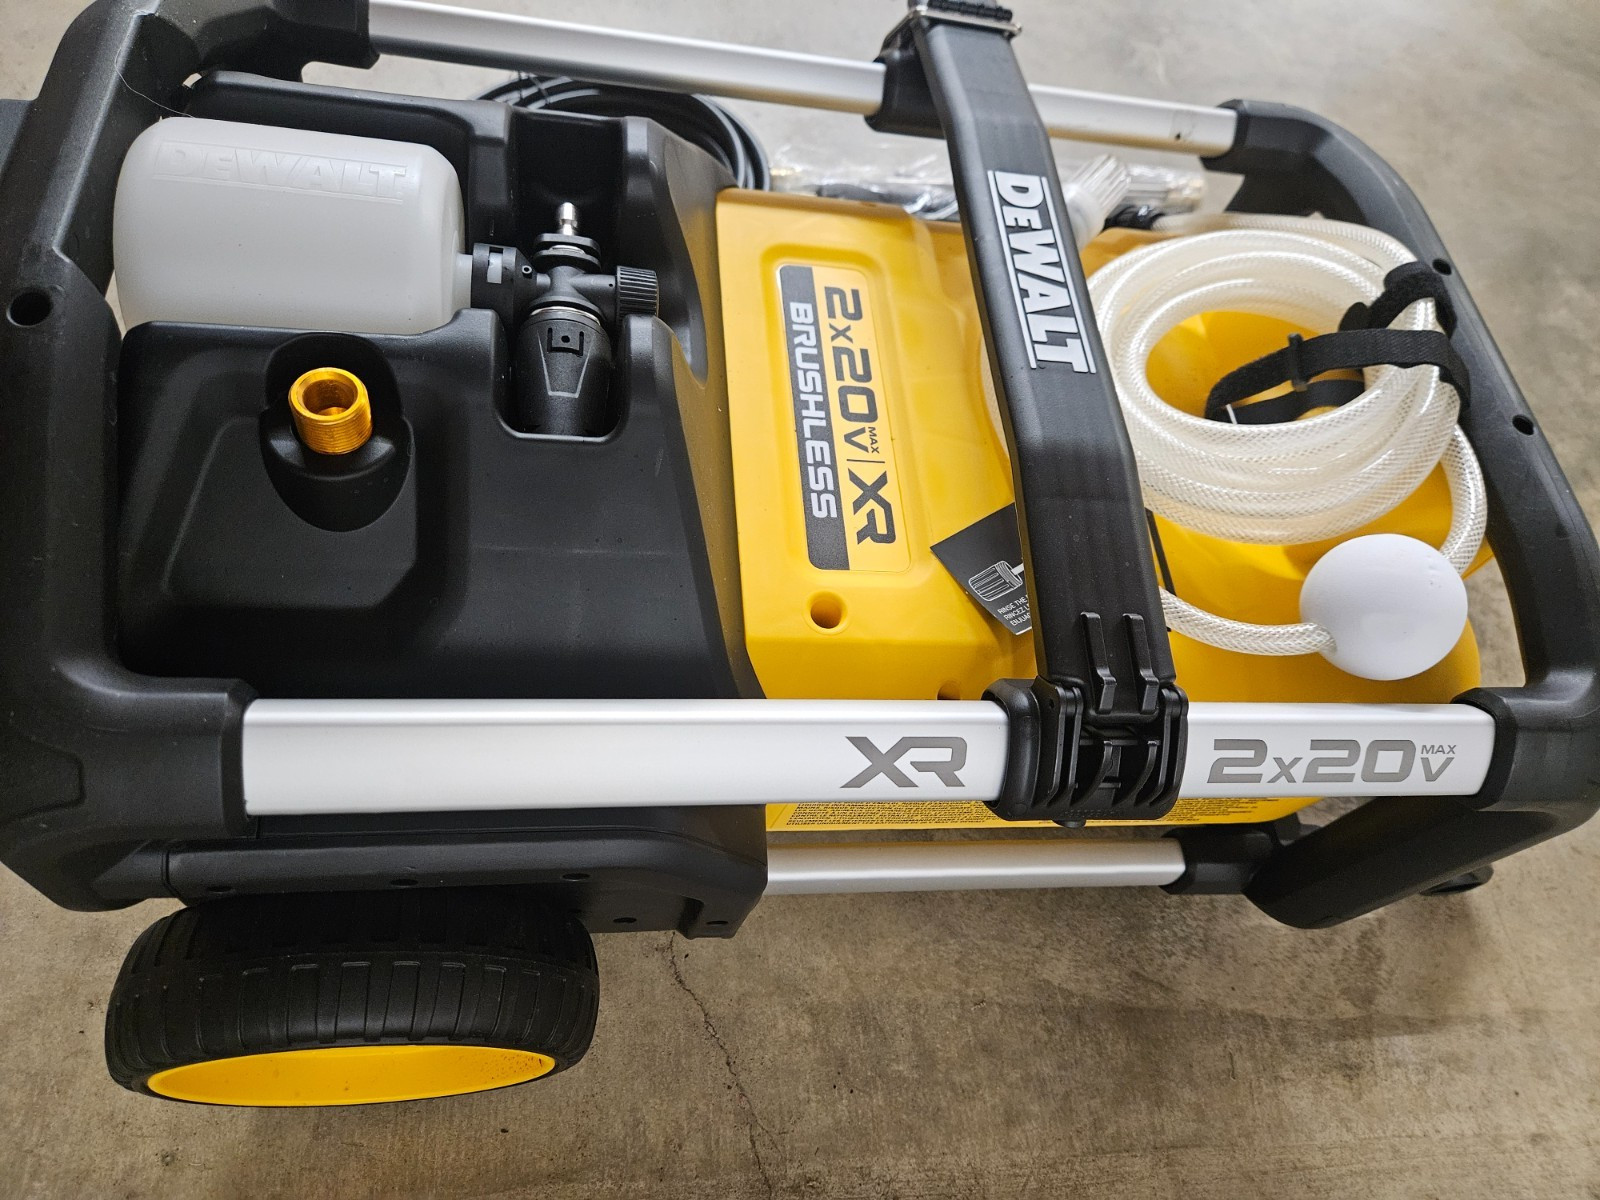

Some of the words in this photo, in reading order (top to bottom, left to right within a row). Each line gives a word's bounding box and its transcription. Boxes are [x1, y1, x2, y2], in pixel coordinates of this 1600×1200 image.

[789, 301, 837, 518] BRUSHLESS
[867, 426, 880, 454] MAX
[848, 467, 897, 545] XR
[997, 603, 1014, 614] RINSE
[1004, 607, 1025, 620] RINCEZ
[839, 736, 968, 788] XR
[1420, 744, 1457, 755] MAX
